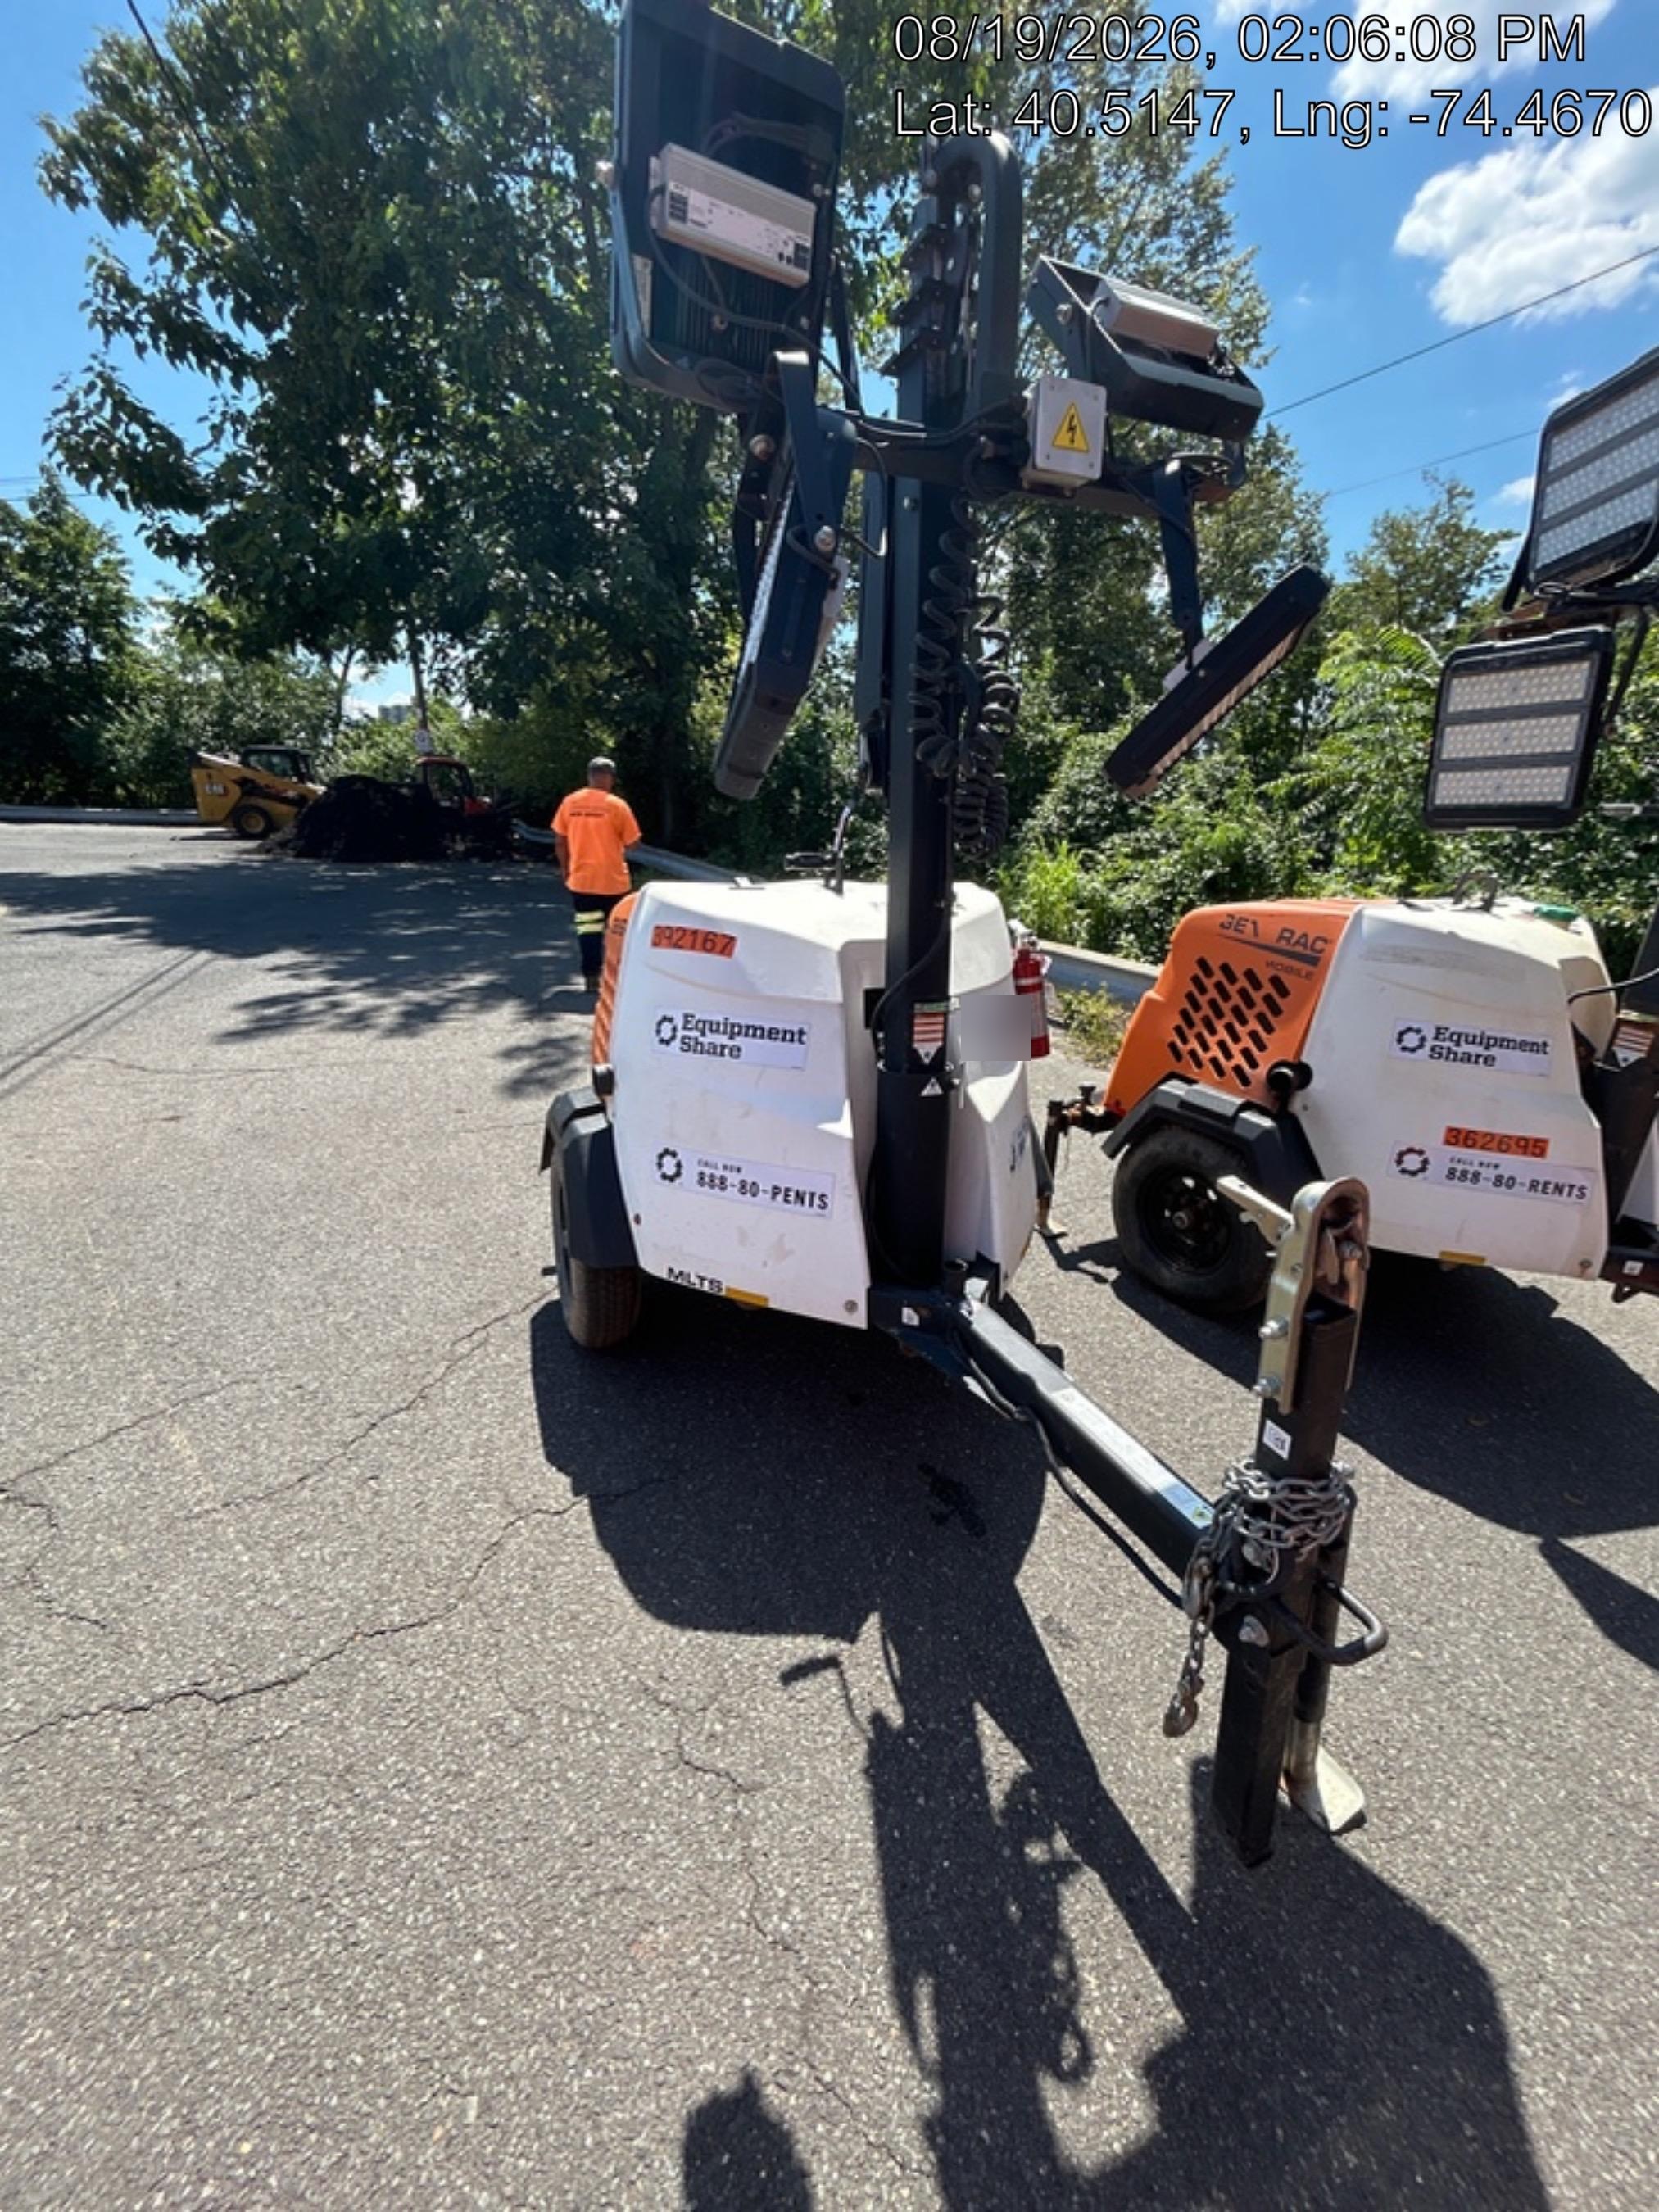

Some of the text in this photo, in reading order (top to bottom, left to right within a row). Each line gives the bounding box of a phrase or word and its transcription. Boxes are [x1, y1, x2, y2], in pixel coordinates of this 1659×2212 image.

[682, 1013, 807, 1045] Equipment
[1432, 1026, 1550, 1055] Equipment
[680, 1035, 742, 1059] Share
[1428, 1045, 1497, 1067] Share
[1444, 1126, 1548, 1158] 362695
[1445, 1167, 1588, 1200] 888-80-RENTS
